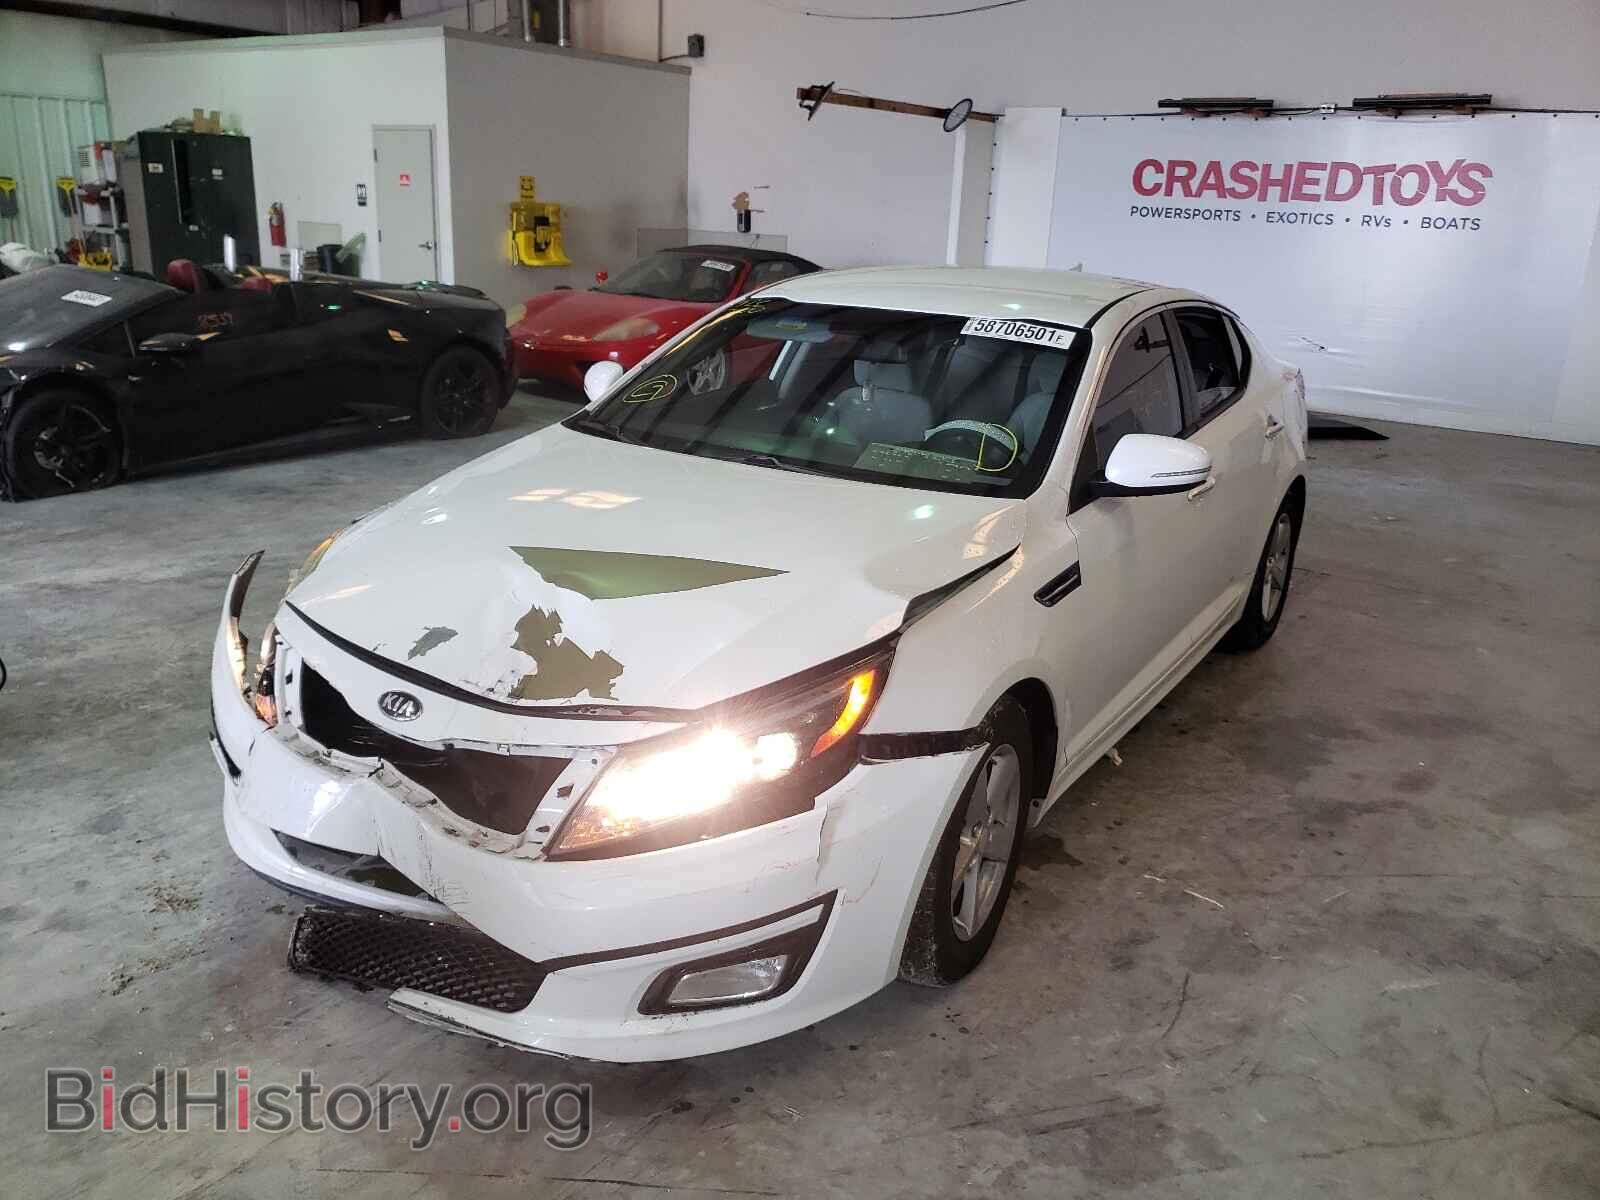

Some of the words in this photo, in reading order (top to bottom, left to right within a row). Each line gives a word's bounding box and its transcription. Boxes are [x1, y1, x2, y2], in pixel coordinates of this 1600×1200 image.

[1132, 158, 1494, 207] CRASHEDTOYS
[1130, 206, 1242, 222] POWERSPORTS
[1265, 211, 1335, 226] EXOTICS
[1361, 214, 1393, 229] RVs
[1420, 216, 1481, 231] BOATS
[382, 693, 415, 717] KIA
